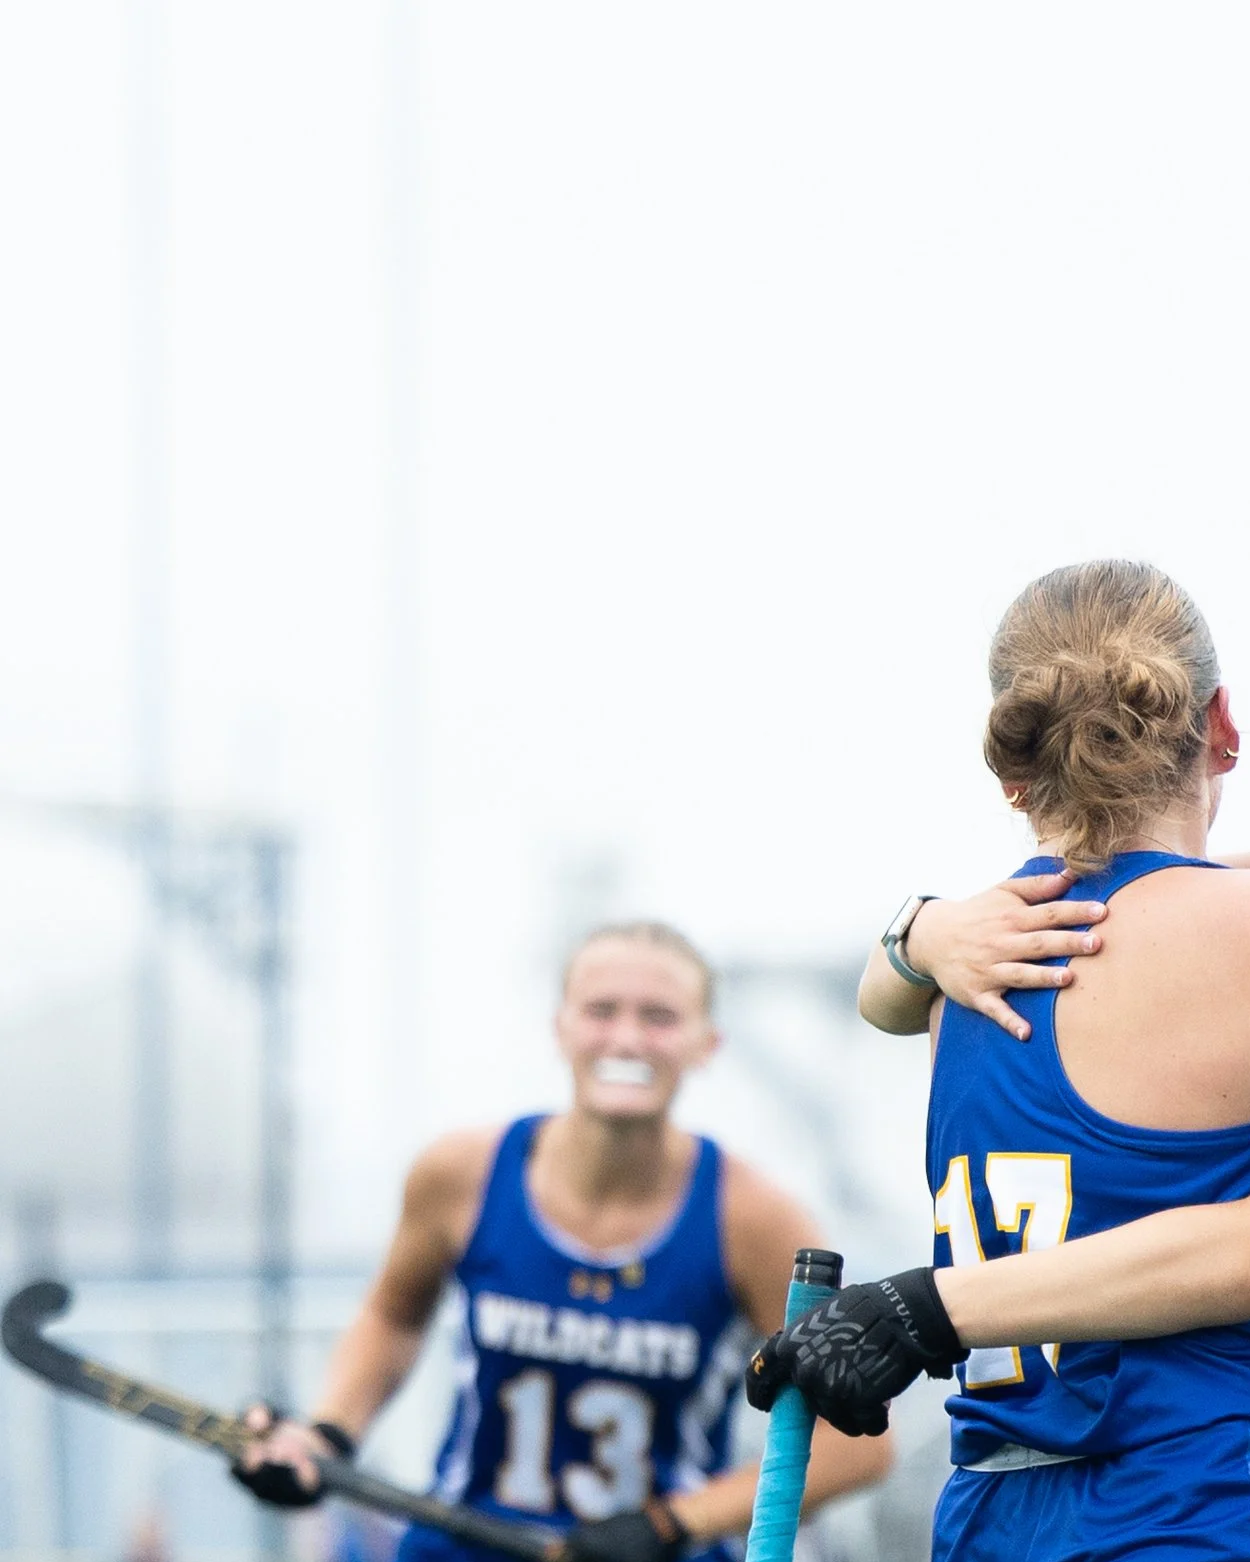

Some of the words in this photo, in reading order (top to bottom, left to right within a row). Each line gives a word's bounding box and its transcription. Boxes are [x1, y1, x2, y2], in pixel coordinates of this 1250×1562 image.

[879, 1280, 921, 1344] RITUAL
[934, 1152, 1073, 1390] 17
[476, 1290, 700, 1381] WILDCATS
[494, 1366, 655, 1522] 13
